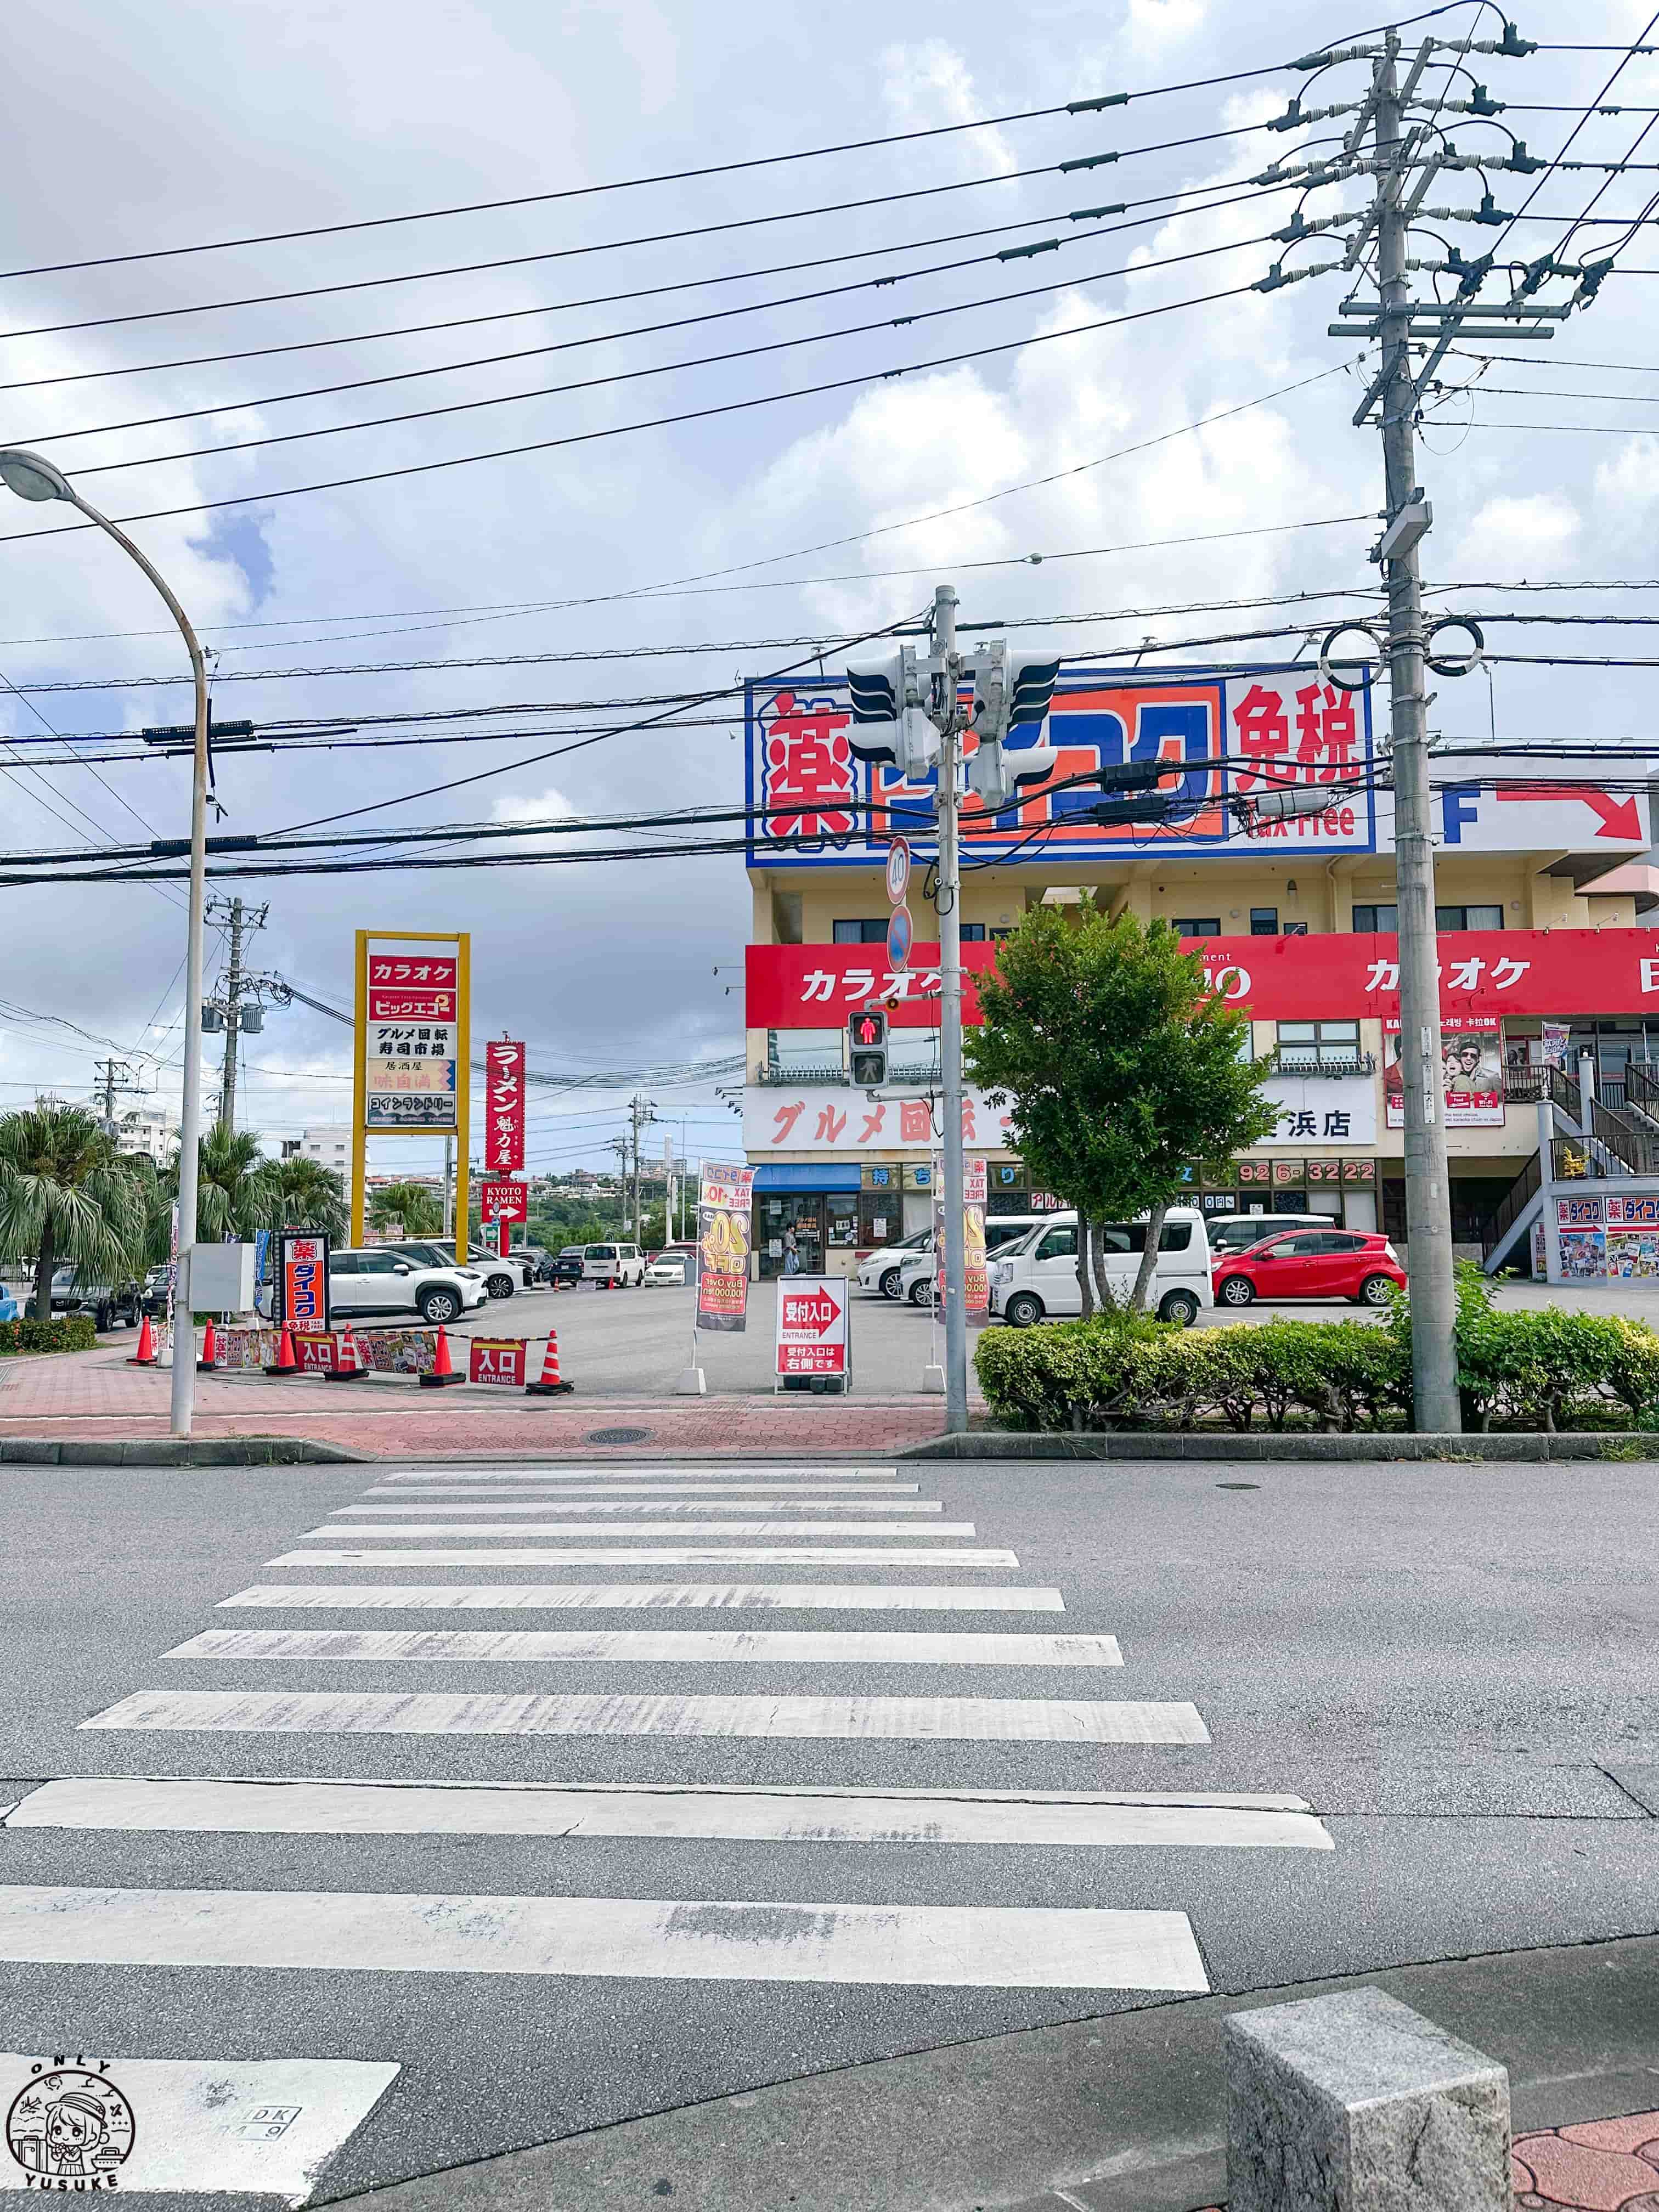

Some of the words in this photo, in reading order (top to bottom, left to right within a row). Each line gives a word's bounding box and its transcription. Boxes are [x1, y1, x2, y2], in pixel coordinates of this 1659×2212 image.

[1232, 683, 1361, 793] 免税
[766, 692, 854, 839] 薬
[892, 853, 904, 886] 40
[374, 964, 453, 981] カラオケ
[1364, 957, 1531, 992] カオケ
[376, 1000, 450, 1015] ビッグエコー
[377, 1028, 448, 1040] グルメ回転
[379, 1042, 445, 1056] 寿司市場
[386, 1062, 423, 1071] 居酒屋
[493, 1045, 518, 1113] ラーメン
[371, 1097, 453, 1110] コインランドリー
[1268, 1110, 1351, 1137] 浜店
[494, 1115, 515, 1165] 魁力屋
[872, 1167, 1015, 1185] 持ちり
[1239, 1163, 1374, 1181] 926-3222
[487, 1187, 522, 1195] KYOTO
[487, 1196, 523, 1204] RAMEN
[1571, 1201, 1599, 1221] ダイコク
[1608, 1199, 1622, 1219] 薬
[1624, 1199, 1659, 1220] ダイコ
[292, 1239, 317, 1260] 薬
[293, 1263, 317, 1318] ダイコク
[786, 1301, 832, 1322] 受付入口
[289, 1321, 310, 1330] 免税
[304, 1343, 331, 1362] 入口
[787, 1347, 835, 1357] 受付入口は
[478, 1350, 516, 1373] 入口
[787, 1358, 834, 1370] 右側です
[478, 1373, 516, 1384] ENTRANCE
